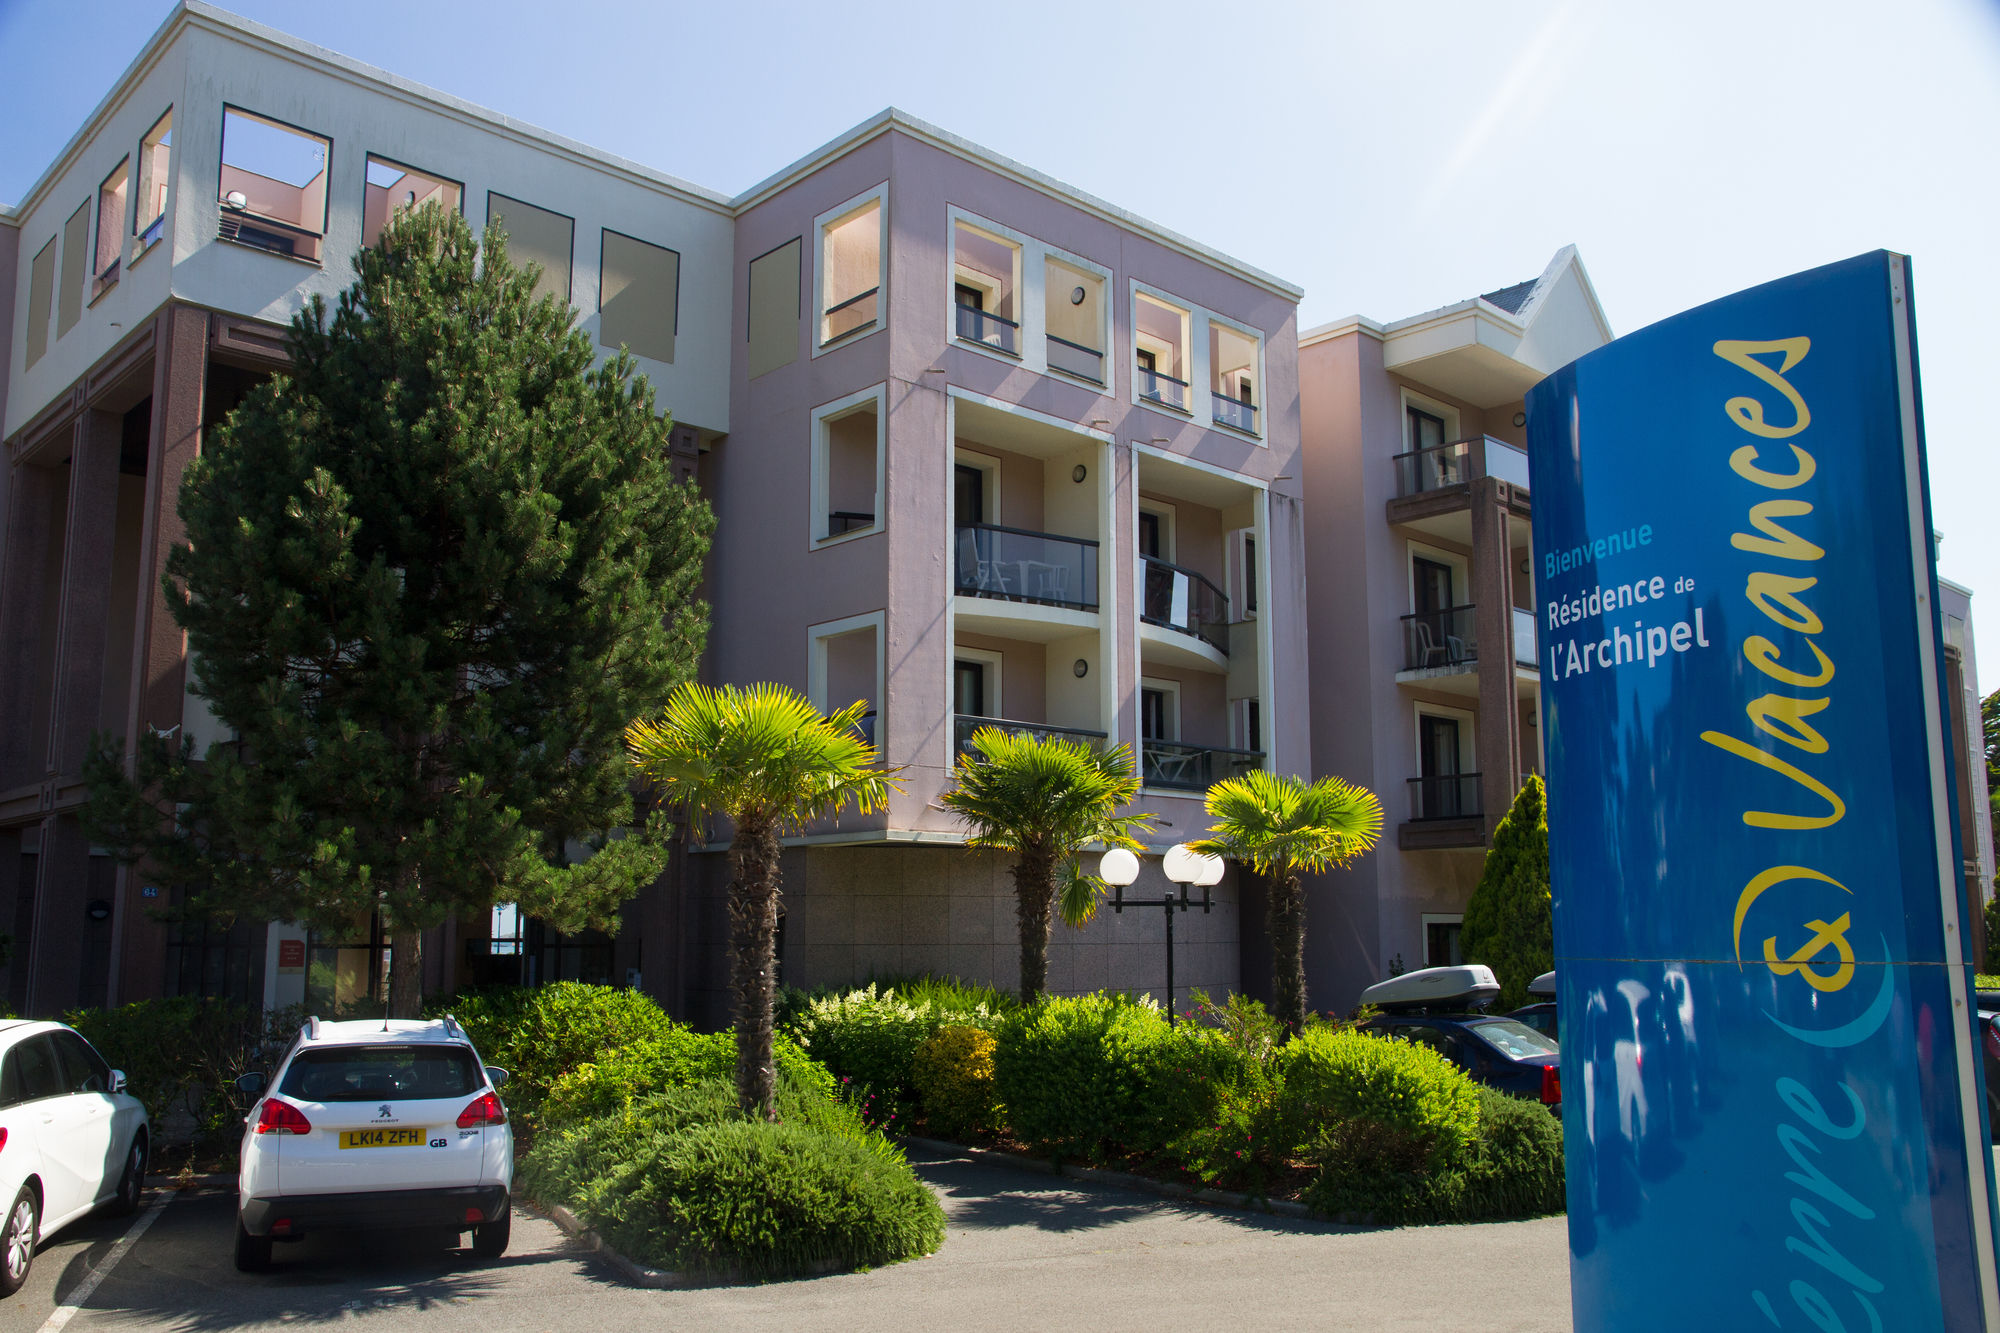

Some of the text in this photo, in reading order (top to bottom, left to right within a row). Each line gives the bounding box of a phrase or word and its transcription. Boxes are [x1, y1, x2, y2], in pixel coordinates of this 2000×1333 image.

[1545, 523, 1653, 580] Bienvenue
[1548, 575, 1696, 631] Résidence de
[1700, 336, 1847, 830] Vacances
[1550, 607, 1710, 682] l'Archipel
[349, 1130, 419, 1146] LK14 ZFH
[429, 1138, 448, 1148] GB
